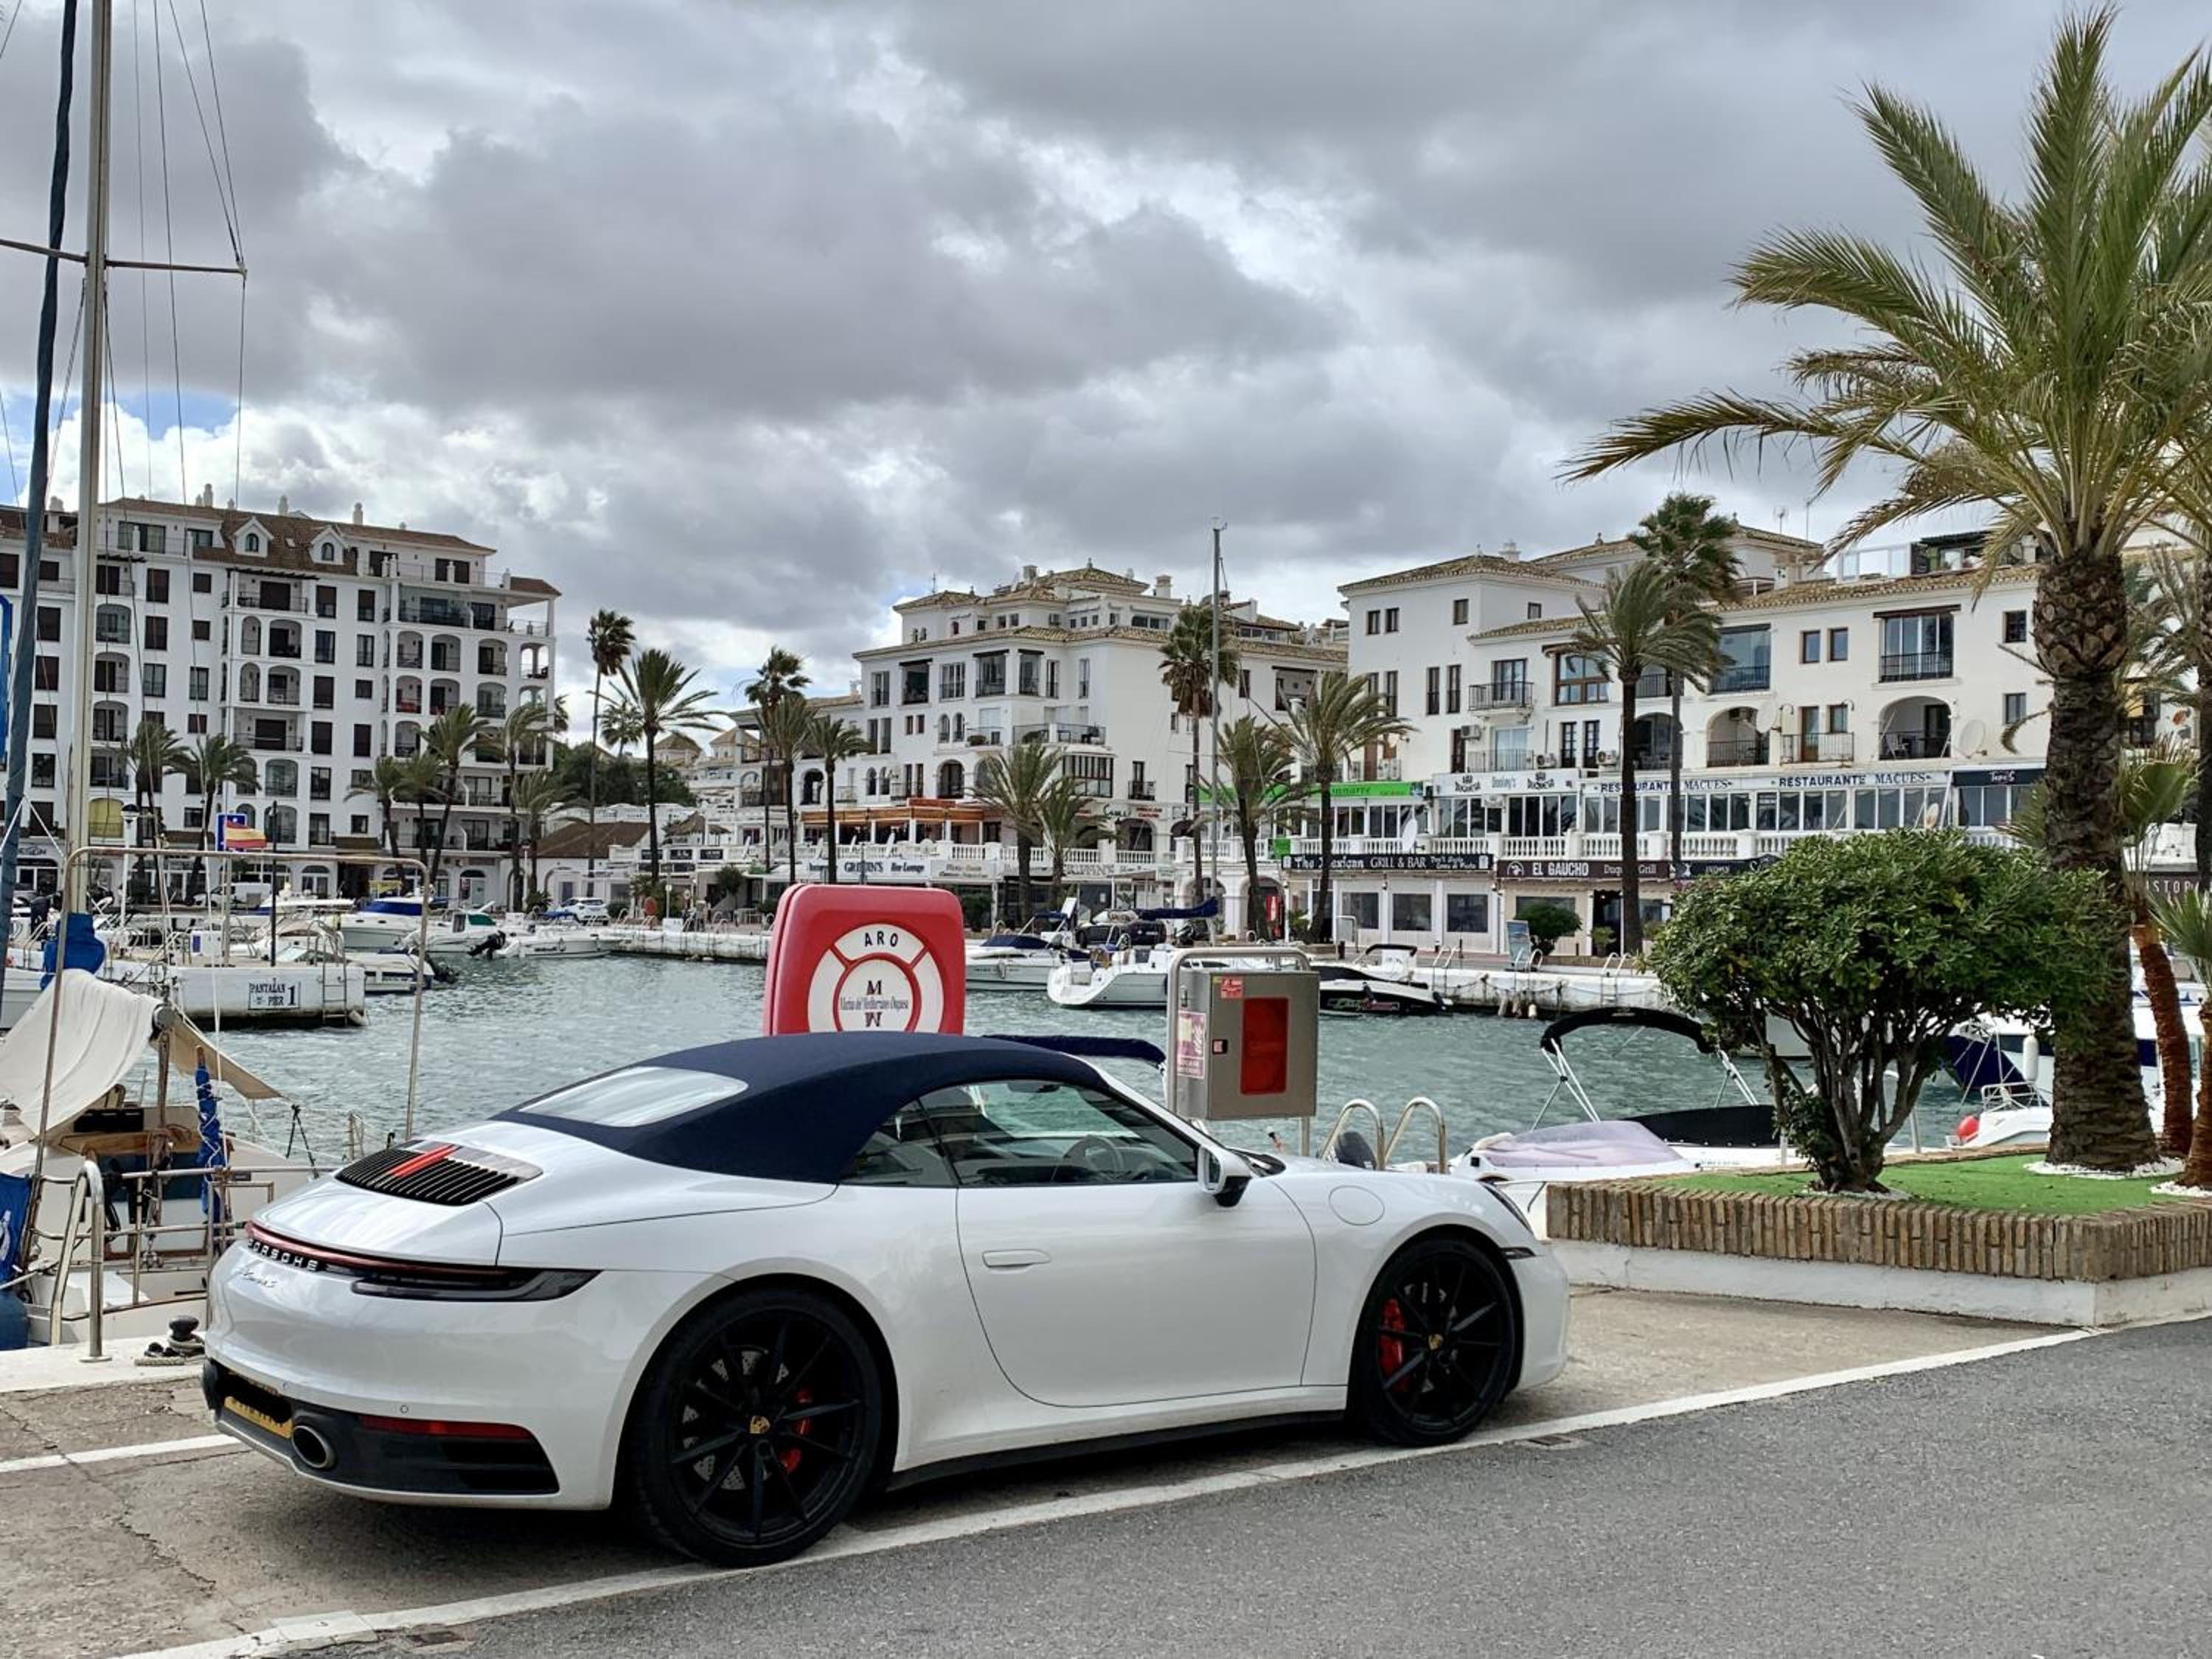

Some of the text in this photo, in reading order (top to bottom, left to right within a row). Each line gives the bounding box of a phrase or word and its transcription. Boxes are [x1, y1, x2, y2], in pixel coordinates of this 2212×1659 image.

[1601, 779, 1728, 793] RESURANT MACUES
[1778, 773, 1927, 787] RESTAURANTE MACUES
[1319, 855, 1364, 869] exican
[1369, 856, 1394, 869] GRILL
[1397, 857, 1405, 868] &
[1408, 856, 1427, 869] BAR
[1532, 862, 1543, 876] EL
[1548, 862, 1589, 877] GAUCHO
[863, 931, 899, 947] ARO
[288, 985, 296, 1006] 1
